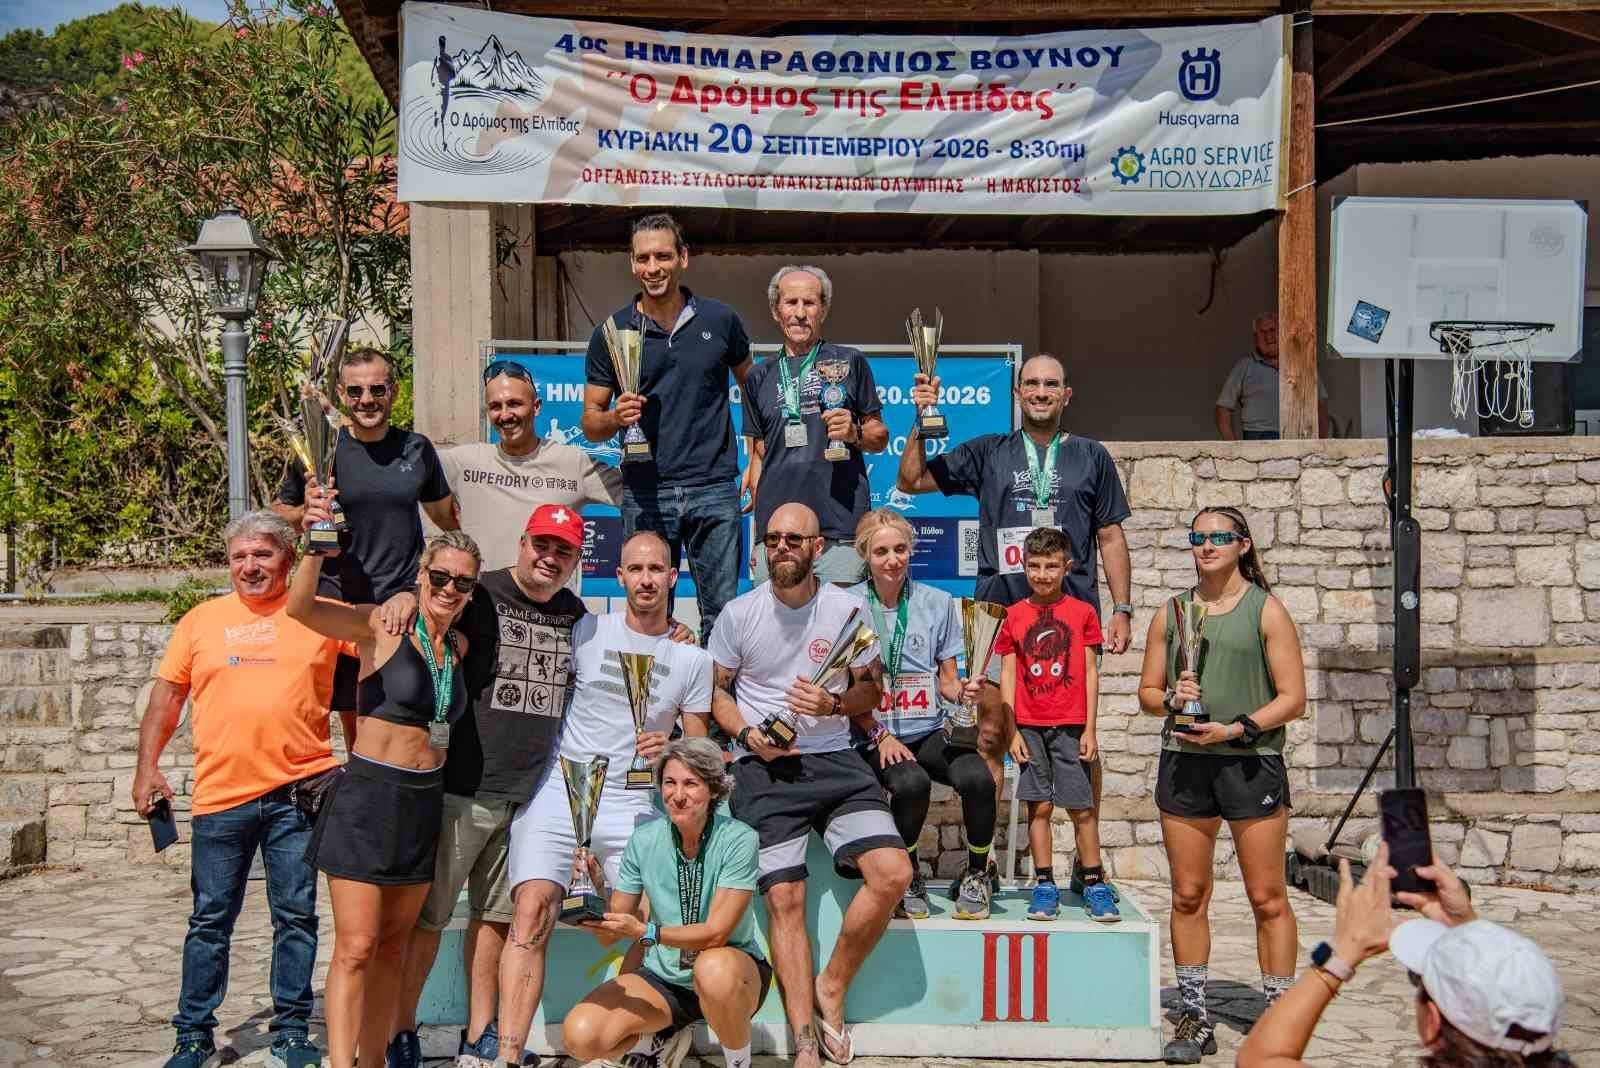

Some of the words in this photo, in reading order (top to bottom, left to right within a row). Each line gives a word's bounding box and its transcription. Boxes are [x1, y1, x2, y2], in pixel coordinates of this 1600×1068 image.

[555, 34, 608, 54] 4ος
[624, 41, 957, 73] ΗΜΙΜΑΡΑΘΩΝΙΟΣ
[970, 45, 1125, 71] ΒΟΥΝΟΥ
[670, 75, 818, 116] Δρόμος
[830, 87, 887, 117] της
[450, 111, 459, 127] Ο
[462, 112, 507, 133] Δρόμος
[511, 117, 529, 133] της
[532, 115, 580, 136] Ελπίδας
[1158, 110, 1240, 129] Husqvarna
[708, 123, 752, 154] 20
[762, 135, 925, 157] ΣΕΠΤΕΜΒΡΙΟΥ
[933, 138, 989, 159] 2026
[1010, 140, 1085, 162] 8:30πμ
[1150, 146, 1196, 166] AGRO
[1203, 140, 1274, 166] SERVICE
[582, 168, 677, 186] ΟΡΓΑΝΩΣΗ:
[683, 172, 767, 189] ΣΥΛΛΟΓΟΣ
[773, 174, 874, 191] ΜΑΚΙΣΤΑΙΩΝ
[880, 176, 964, 192] ΟΛΥΜΠΙΑΣ
[1150, 163, 1273, 189] ΠΟΛΥΔΩΡΑΣ
[463, 469, 530, 488] SUPERDRY
[496, 602, 530, 620] GAME
